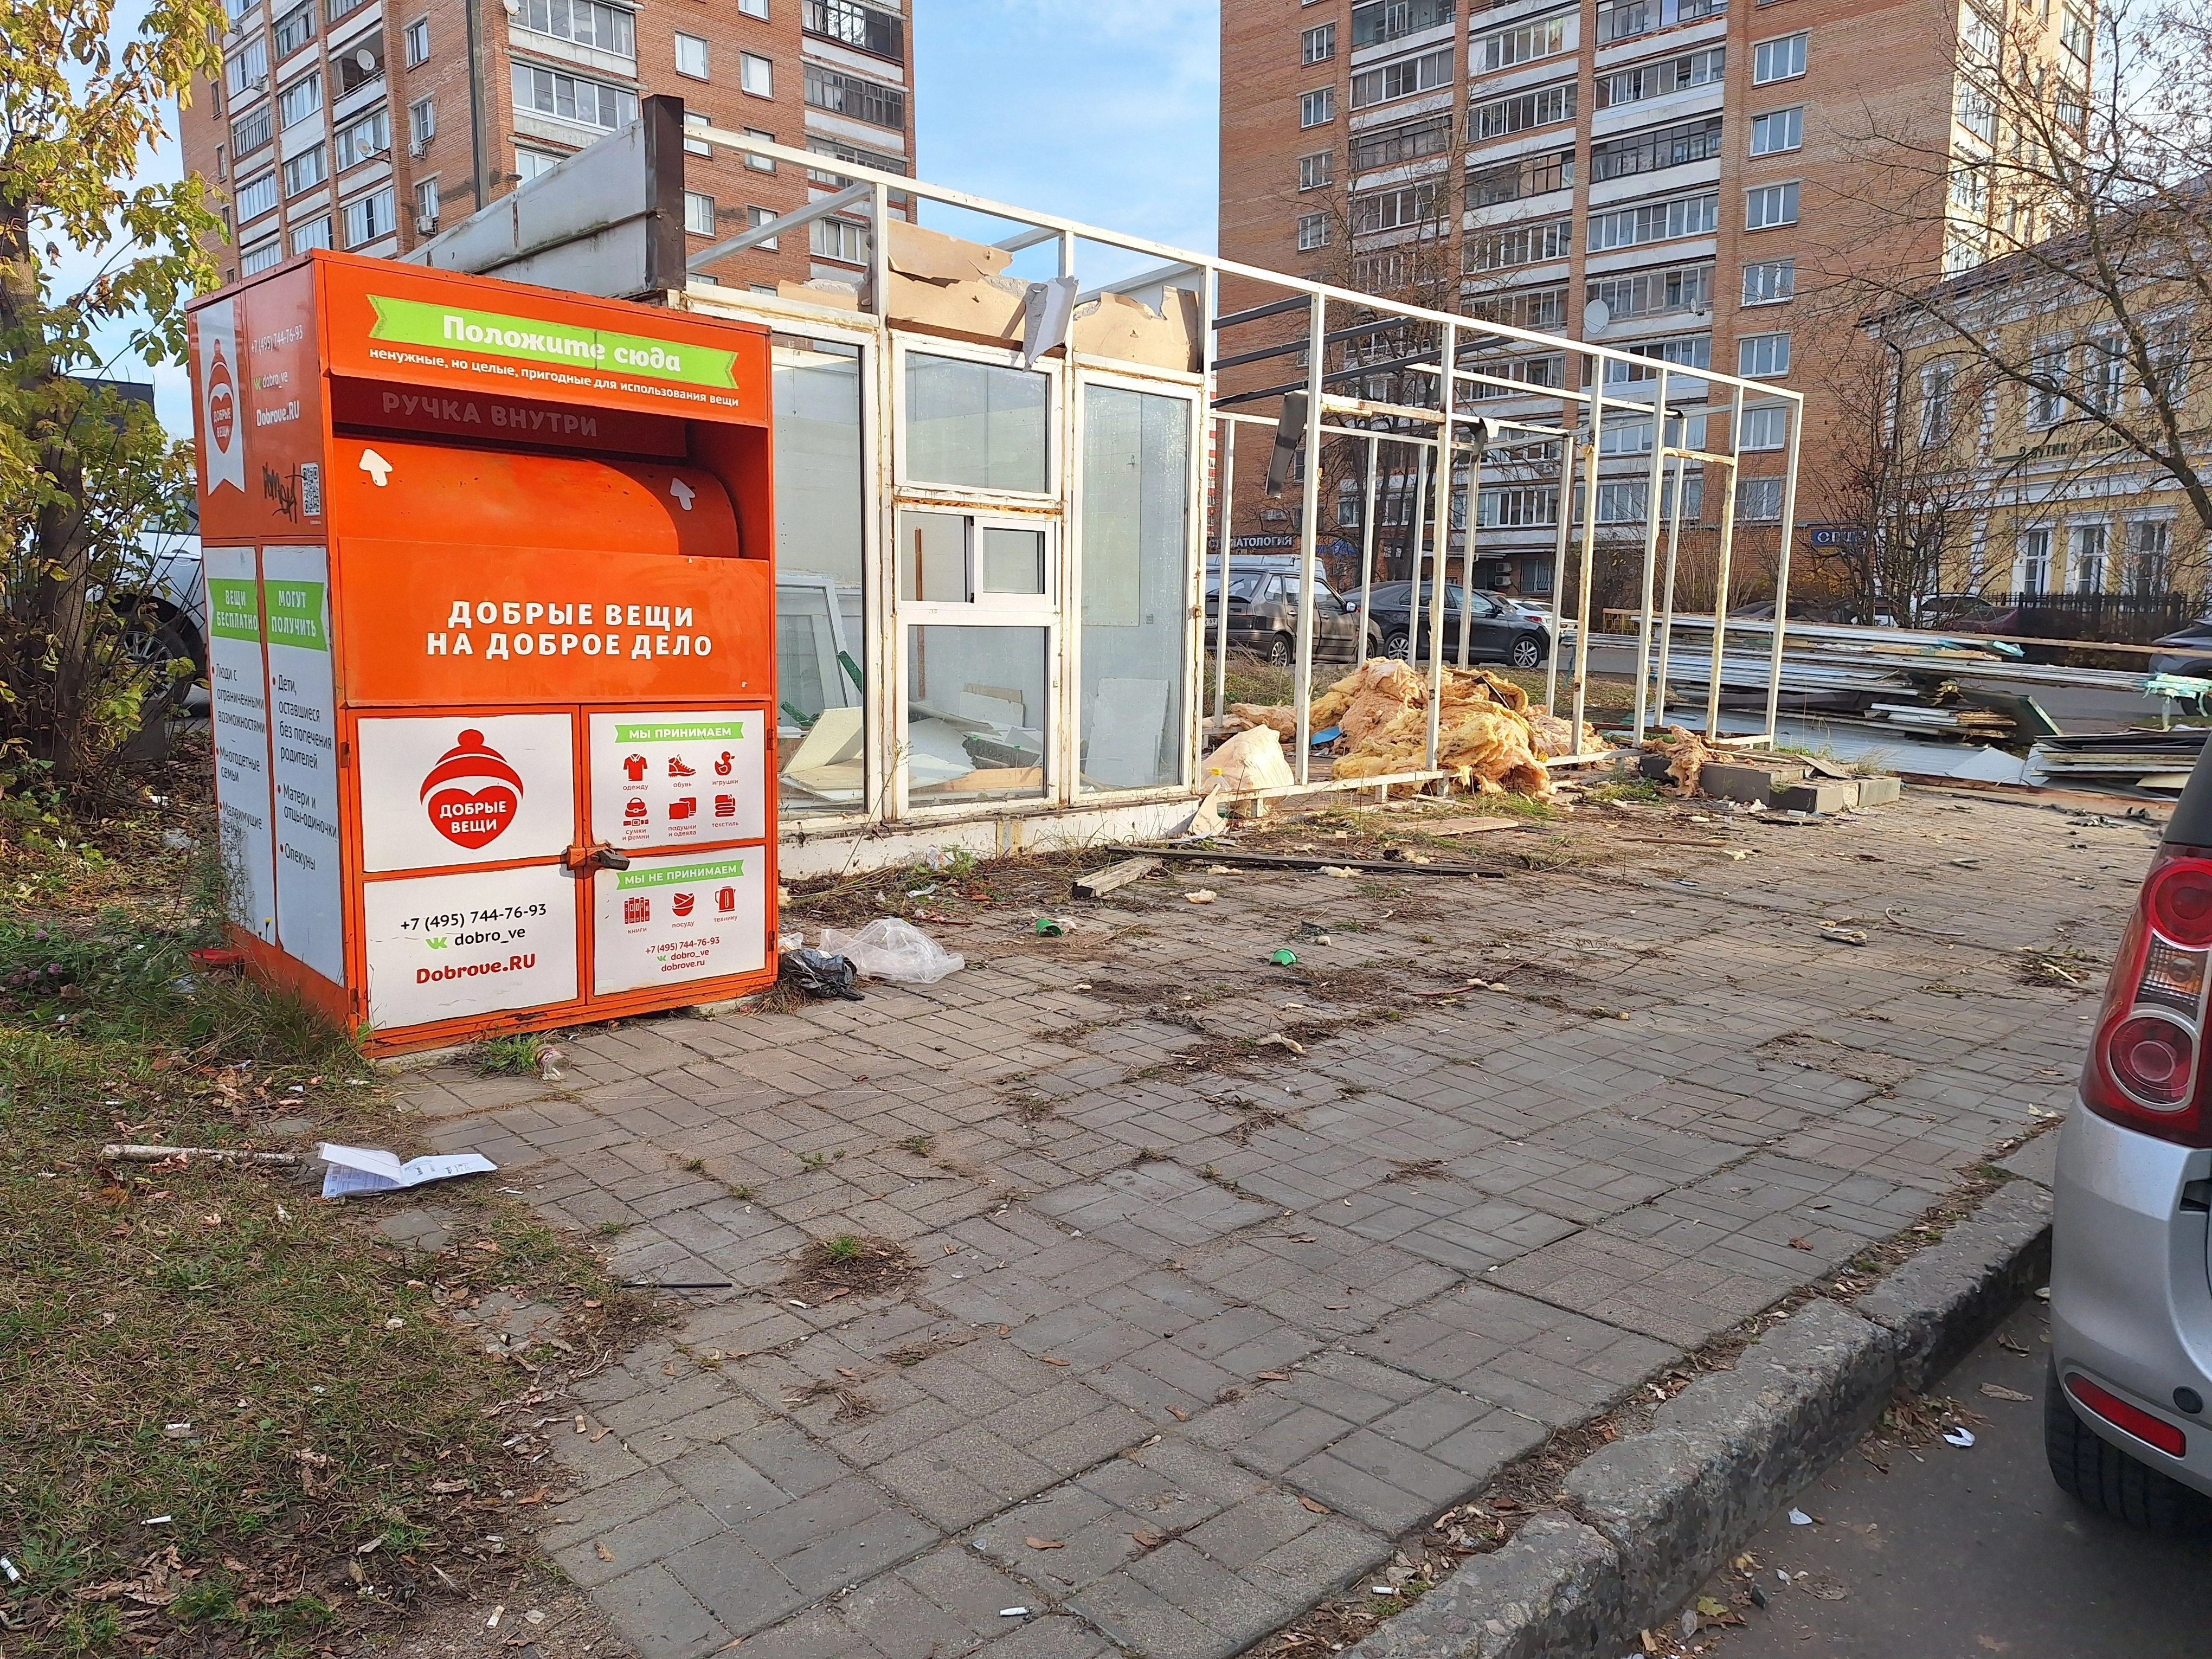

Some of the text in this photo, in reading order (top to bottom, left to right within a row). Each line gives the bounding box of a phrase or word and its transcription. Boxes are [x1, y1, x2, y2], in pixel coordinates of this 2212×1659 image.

[252, 324, 303, 356] +7 (495) 744-76-93
[443, 314, 681, 372] Положите сюда
[262, 371, 288, 389] dobro_ve
[369, 349, 739, 407] ненужные, но целые, пригодные для использования вещи
[214, 407, 232, 424] ДОБРЫЕ
[382, 391, 597, 437] РУЧКА ВНУТРИ
[217, 425, 232, 439] ВЕЩИ
[226, 590, 246, 609] ВЕЩИ
[279, 590, 306, 608] МОГУТ
[217, 612, 258, 631] БЕСПЛАТНО
[271, 615, 316, 638] ПОЛУЧИТЬ
[447, 601, 693, 632] ДОБРЫЕ ВЕЩИ
[427, 632, 712, 660] НА ДОБРОЕ ДЕЛО
[216, 664, 237, 681] Люди с
[278, 674, 297, 696] Дети,
[217, 689, 264, 710] ограниченными
[218, 711, 265, 734] возможностями
[279, 701, 320, 723] оставшиеся
[279, 721, 332, 750] без попечения
[629, 727, 731, 739] МЫ ПРИНИМАЕМ
[220, 745, 260, 772] Многодетные
[280, 747, 318, 769] родителей
[221, 766, 239, 783] семьи
[283, 783, 316, 809] Матери и
[439, 801, 507, 819] ДОБРЫЕ
[284, 806, 337, 839] отцы-одиночки
[451, 818, 497, 833] ВЕЩИ
[285, 843, 316, 871] Опекуны
[625, 865, 737, 885] МЫ НЕ ПРИНИМАЕМ
[400, 903, 547, 931] +7 (495) 744-76-93
[672, 921, 695, 929] посуду
[454, 928, 526, 946] dobro_ve
[645, 936, 720, 954] +7 (495) 744-76-93
[671, 949, 710, 961] dobro_ve
[416, 953, 536, 984] Dobrove.RU
[661, 960, 705, 972] dobrove.ru
